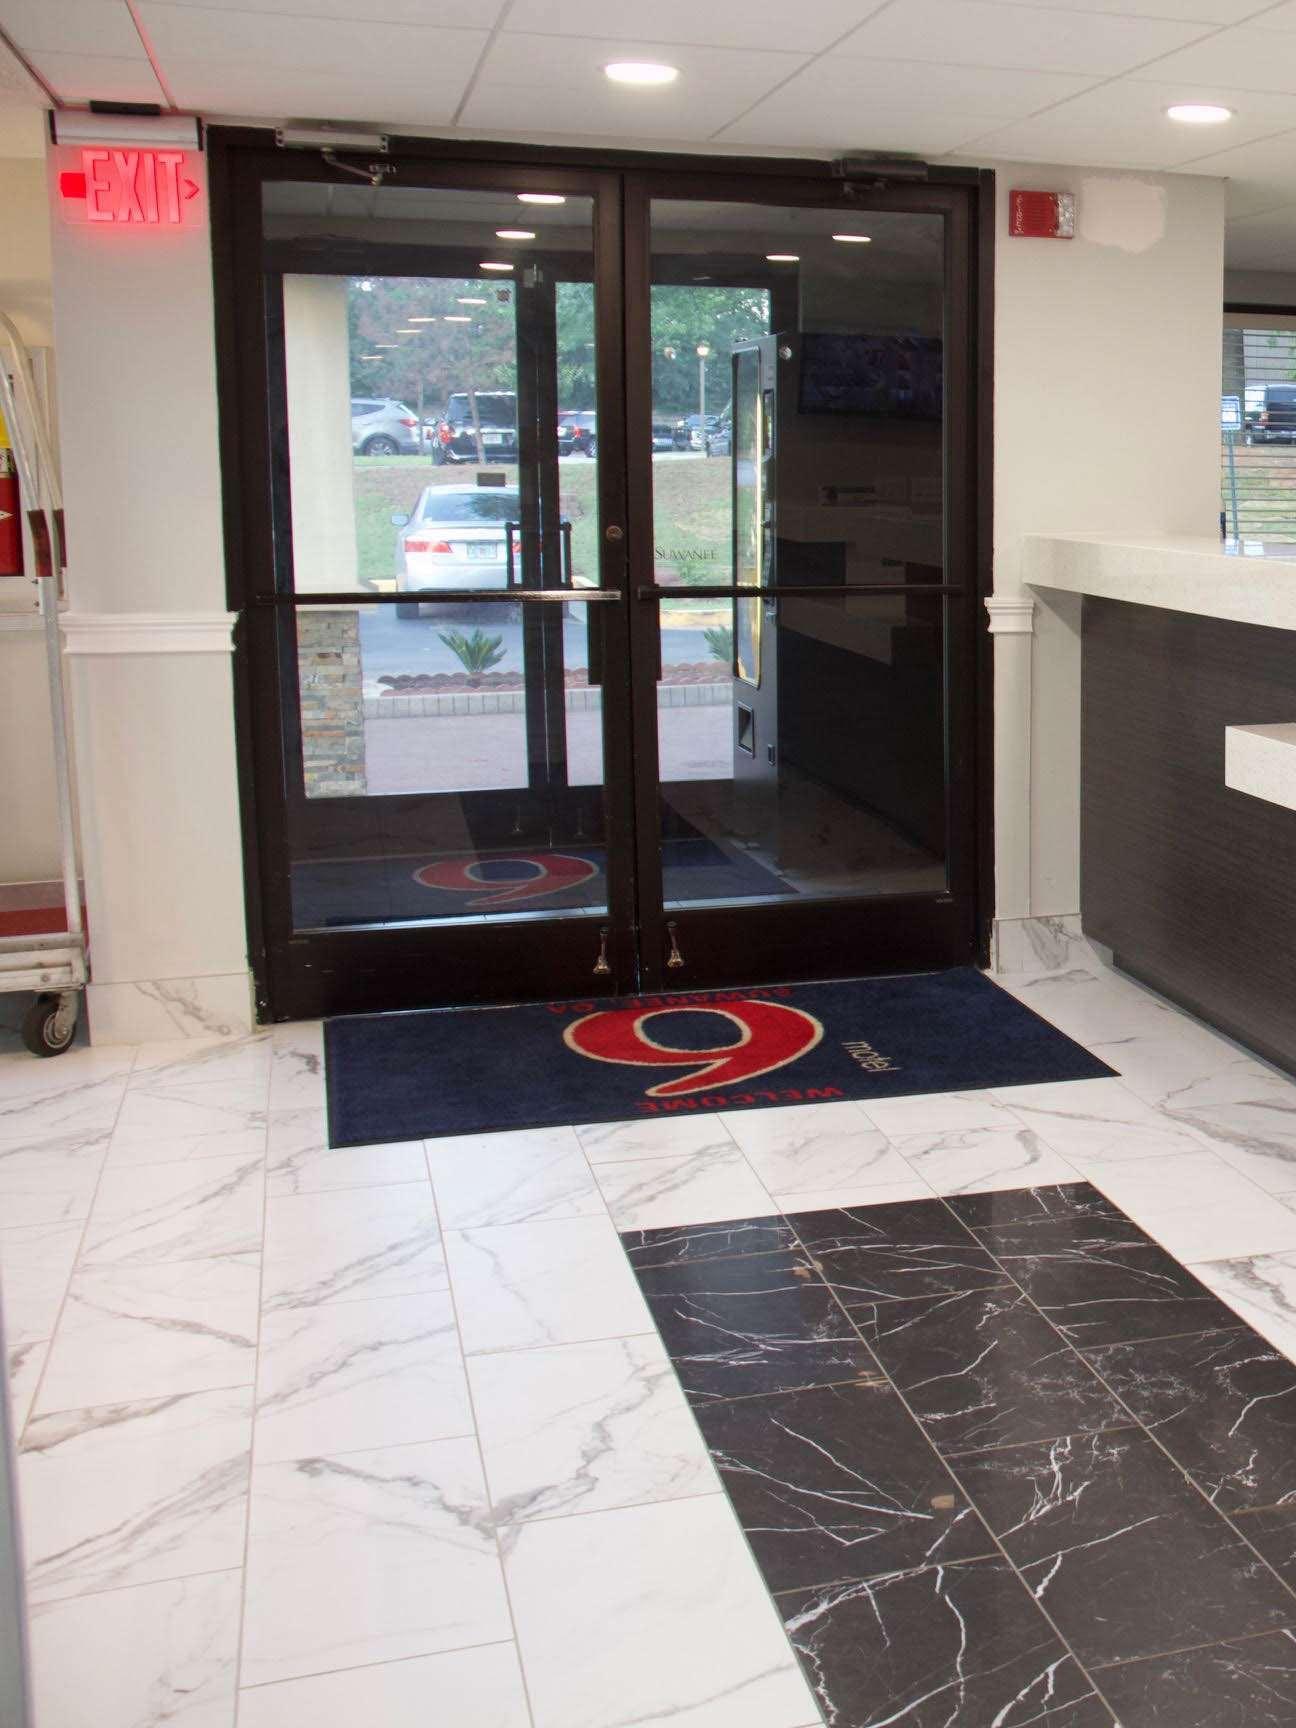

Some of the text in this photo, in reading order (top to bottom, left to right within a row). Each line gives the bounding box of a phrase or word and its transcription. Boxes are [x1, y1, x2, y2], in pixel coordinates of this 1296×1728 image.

[82, 150, 184, 223] EXIT
[563, 1000, 903, 1098] motel 6
[635, 1086, 844, 1114] WELCOME
